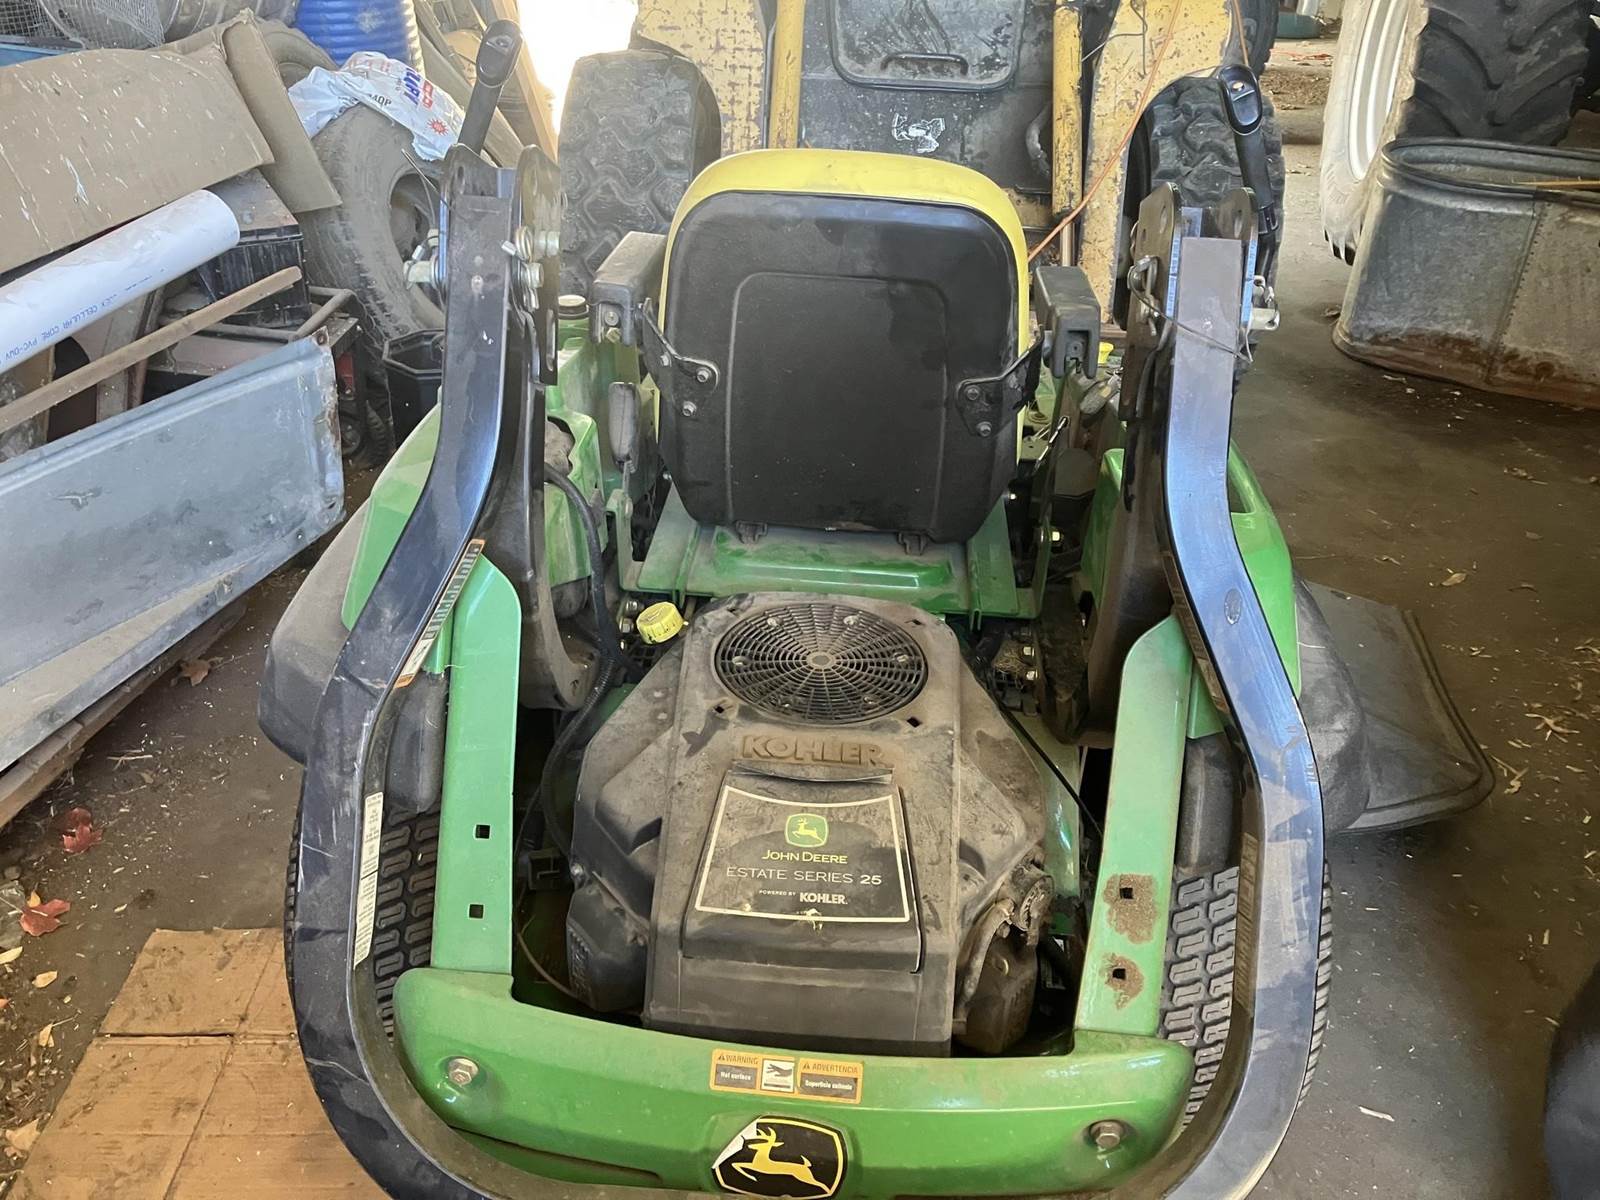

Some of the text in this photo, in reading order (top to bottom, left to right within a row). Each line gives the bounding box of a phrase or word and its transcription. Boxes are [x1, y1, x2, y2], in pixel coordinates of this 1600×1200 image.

[63, 305, 99, 330] CELLULAR
[41, 326, 61, 340] CORE
[741, 735, 885, 765] KOHLER
[762, 850, 848, 864] JOHN DEERE
[726, 866, 882, 885] ESTATE SERIES 25
[726, 1055, 759, 1065] WARNING
[812, 1063, 858, 1074] ADVERTENCIA
